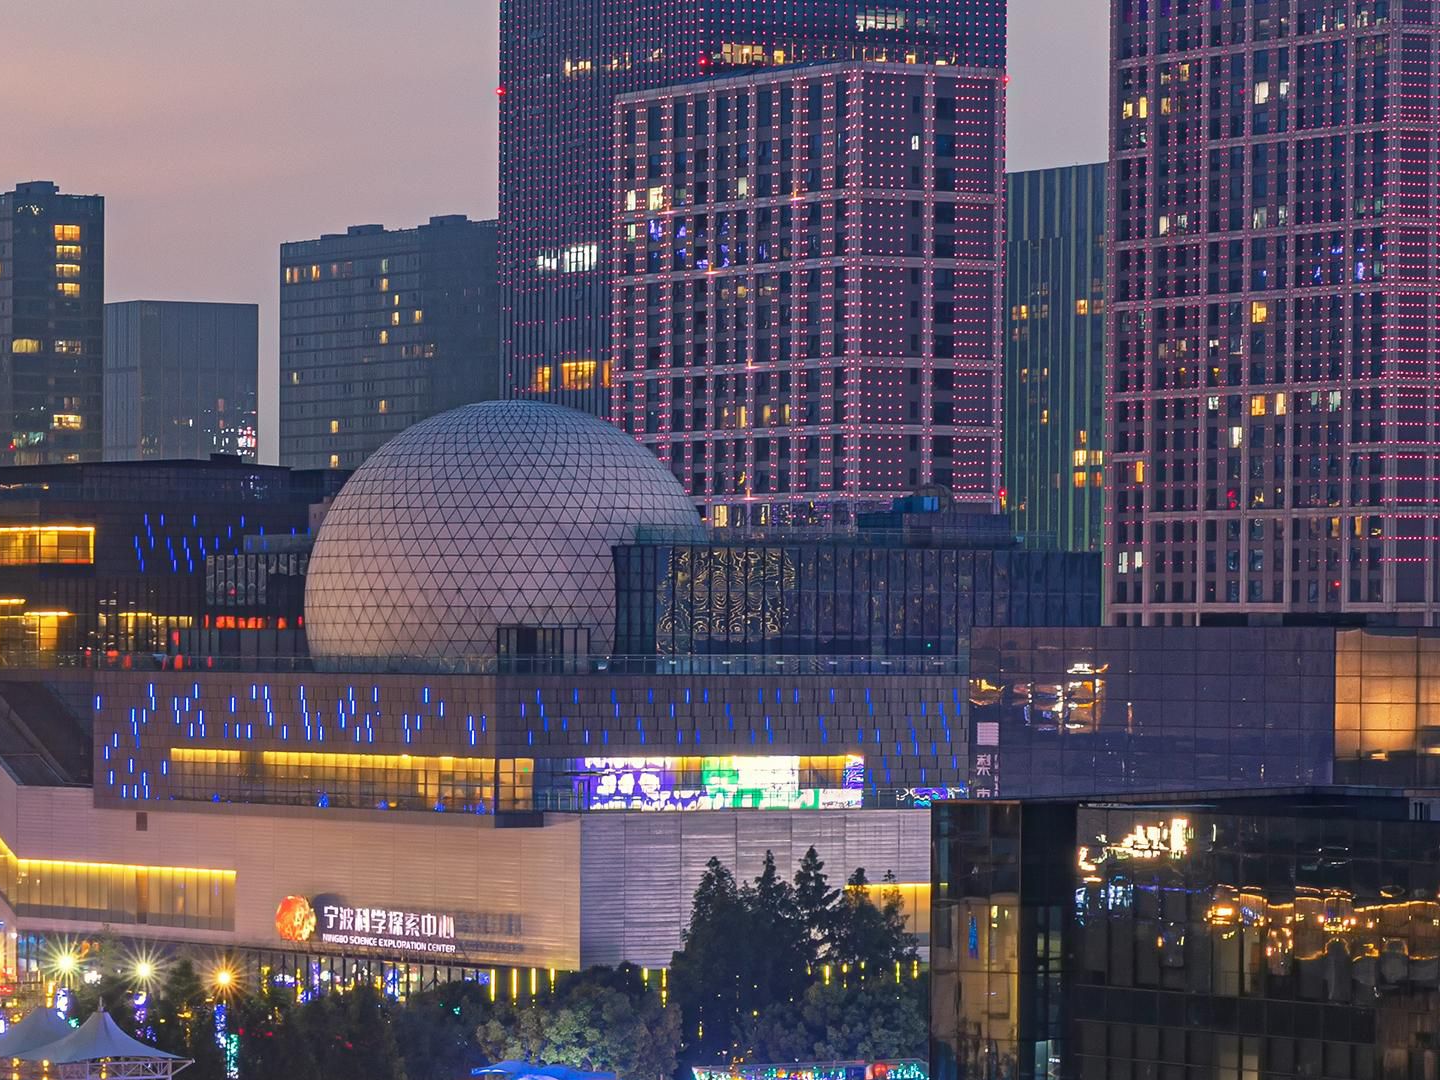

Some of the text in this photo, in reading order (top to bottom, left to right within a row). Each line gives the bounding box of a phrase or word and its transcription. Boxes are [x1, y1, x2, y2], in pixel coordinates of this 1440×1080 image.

[323, 905, 455, 939] 宁波科学探索中心
[322, 933, 456, 953] NINGBO SCIENCE EXPLORATION CENTER
